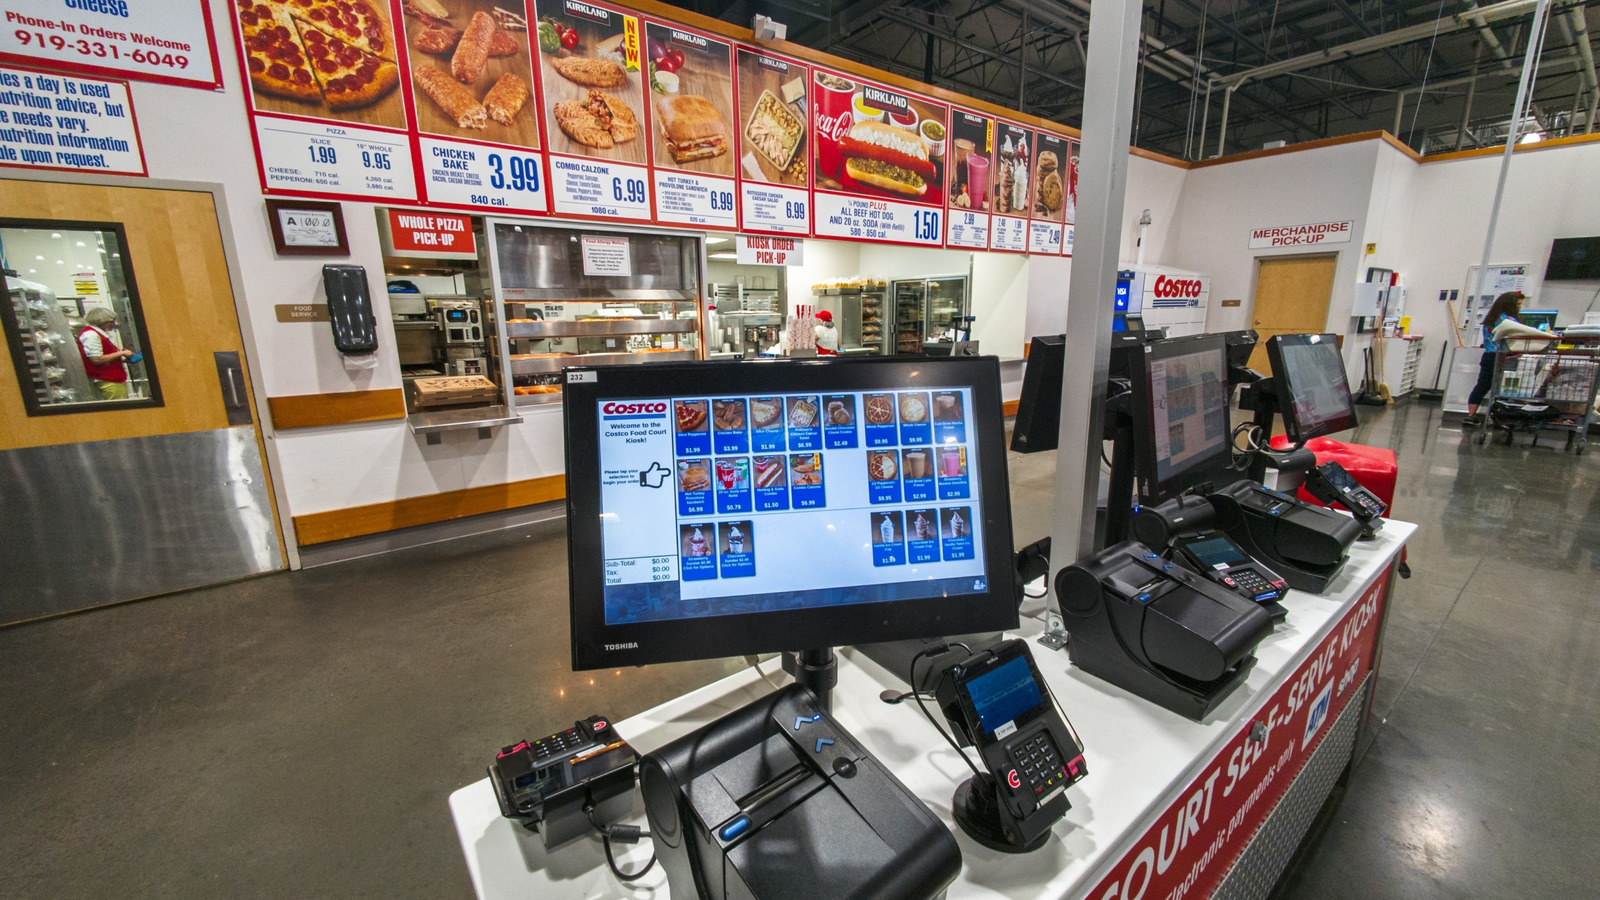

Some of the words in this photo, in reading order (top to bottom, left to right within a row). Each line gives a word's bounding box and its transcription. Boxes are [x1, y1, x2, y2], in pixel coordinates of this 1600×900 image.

[566, 1, 608, 19] KIRKLAND
[5, 10, 76, 33] Phone-In
[80, 23, 127, 41] Orders
[130, 32, 192, 52] Welcome
[672, 30, 707, 47] KIRKLAND
[14, 29, 189, 69] 919-331-6049
[626, 20, 638, 63] NEW
[759, 56, 788, 70] KIRKLAND
[24, 75, 33, 89] a
[36, 75, 60, 94] day
[63, 78, 75, 94] is
[80, 83, 111, 99] used
[865, 88, 907, 108] KIRKLAND
[56, 97, 102, 117] advice,
[104, 101, 125, 118] but
[12, 111, 53, 128] needs
[56, 116, 90, 133] vary.
[326, 127, 347, 136] PIZZA
[56, 131, 130, 153] information
[310, 138, 331, 146] SLICE
[368, 145, 393, 153] WHOLE
[20, 149, 53, 164] upon
[56, 152, 110, 168] request.
[308, 145, 337, 165] 1.99
[362, 151, 391, 170] 9.95
[432, 147, 476, 161] CHICKEN
[269, 166, 301, 175] CHEESE:
[442, 159, 469, 171] BAKE
[488, 153, 540, 193] 3.99
[555, 161, 580, 171] COMBO
[581, 164, 610, 175] CALZONE
[270, 174, 315, 184] PEPPERONI:
[659, 181, 685, 190] PROVOLONE
[685, 185, 708, 193] SANDWICH
[612, 177, 646, 204] 6.99
[471, 194, 488, 205] 840
[491, 197, 508, 206] cal.
[710, 190, 733, 211] 6.99
[853, 201, 868, 209] POUND
[869, 201, 888, 211] PLUS
[786, 201, 805, 220] 6.99
[841, 207, 852, 216] ALL
[854, 208, 868, 218] BEEF
[869, 210, 881, 219] HOT
[882, 212, 894, 220] DOG
[287, 217, 297, 226] A
[398, 215, 435, 230] WHOLE
[437, 218, 465, 232] PIZZA
[829, 216, 842, 225] AND
[843, 217, 851, 226] 20
[853, 219, 861, 227] oz.
[862, 219, 878, 228] SODA
[914, 210, 939, 240] 1.50
[413, 231, 454, 246] PICK-UP
[850, 228, 861, 236] 580
[866, 229, 877, 237] 850
[878, 230, 887, 238] cal.
[1253, 222, 1349, 239] MERCHANDISE
[747, 236, 770, 249] KIOSK
[772, 237, 794, 251] ORDER
[1272, 234, 1324, 246] PICK-UP
[757, 251, 786, 264] PICK-UP
[1154, 275, 1202, 298] COSTCO
[603, 402, 667, 415] COSTCO
[604, 642, 639, 651] TOSHIBA
[1223, 635, 1338, 798] SELF-SERVE
[1339, 584, 1382, 658] KIOSK
[1226, 765, 1276, 842] payments
[1277, 738, 1296, 773] only
